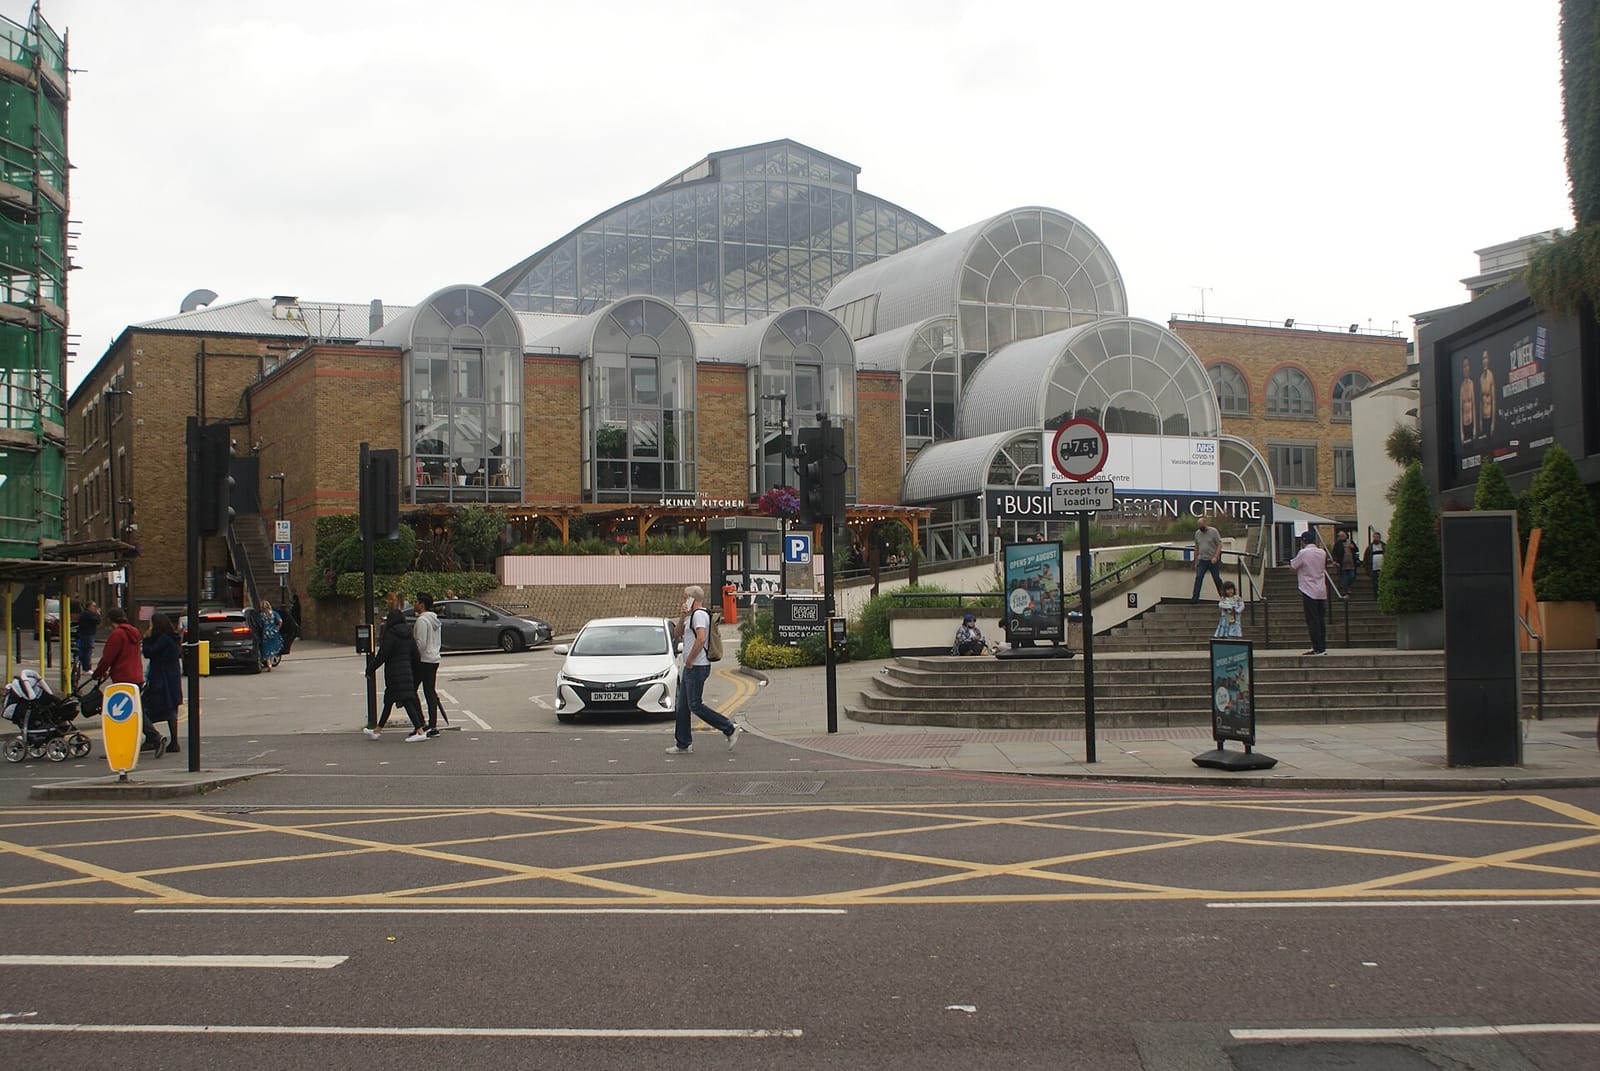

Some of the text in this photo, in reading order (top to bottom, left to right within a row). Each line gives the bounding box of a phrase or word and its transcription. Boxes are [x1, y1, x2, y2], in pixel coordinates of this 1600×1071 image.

[1518, 343, 1534, 368] WEEK
[1072, 440, 1089, 453] 7.5
[1197, 443, 1214, 452] NHS
[1107, 473, 1130, 482] Centre
[1056, 485, 1109, 497] Except for
[660, 498, 745, 507] SKINNY KITCHEN
[1064, 497, 1101, 507] loading
[1190, 499, 1261, 519] CENTRE
[791, 539, 804, 558] P
[1036, 550, 1057, 562] AUGUST
